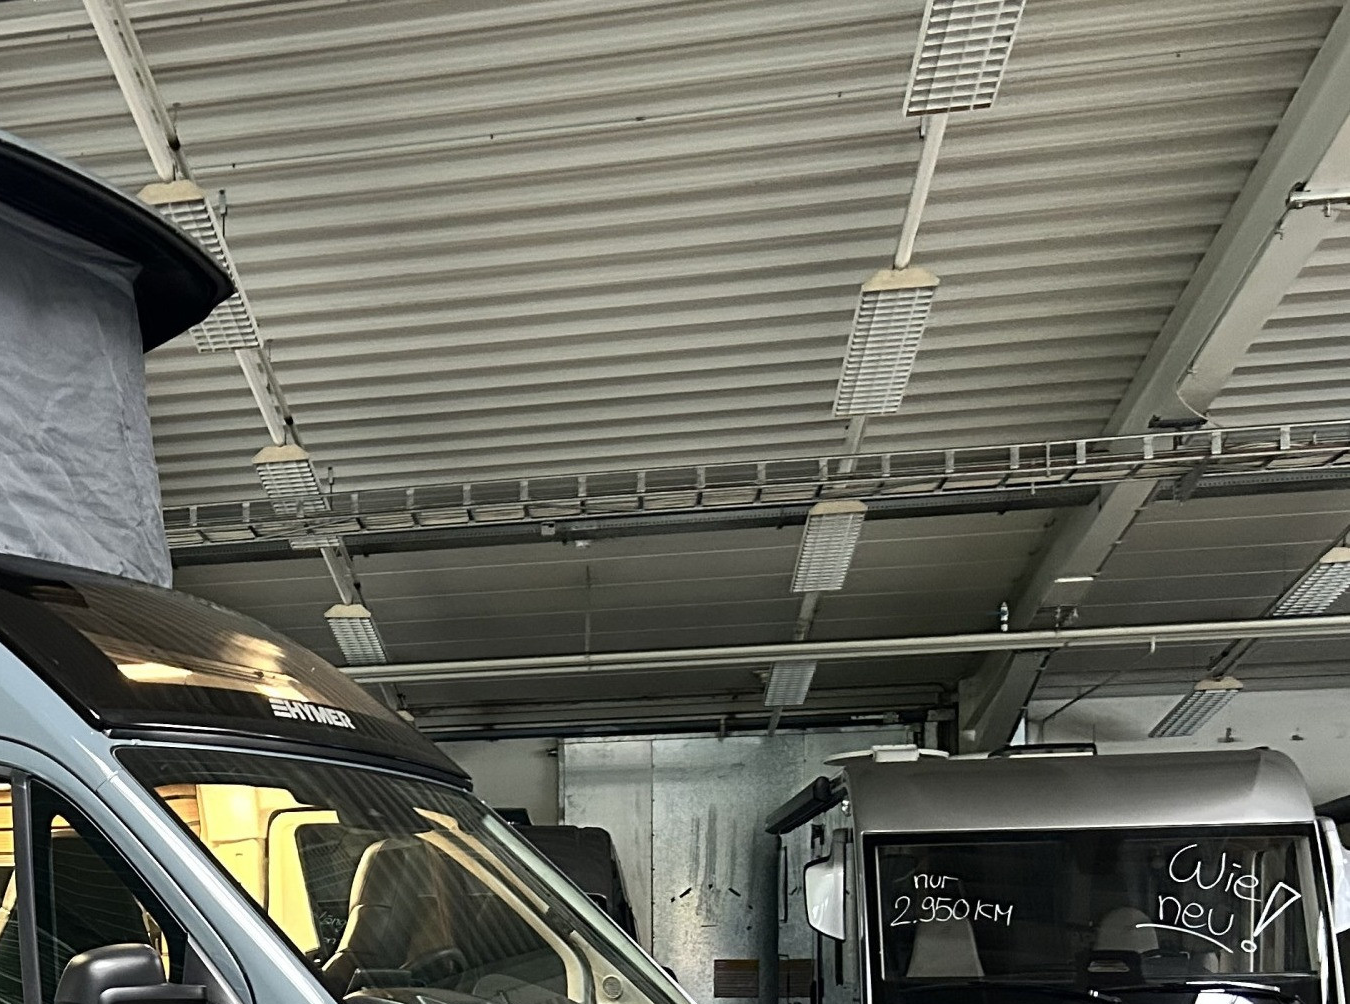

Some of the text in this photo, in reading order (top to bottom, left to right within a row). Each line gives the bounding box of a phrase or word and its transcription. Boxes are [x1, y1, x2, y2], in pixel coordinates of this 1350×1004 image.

[269, 698, 356, 729] HYMER
[913, 873, 959, 889] nur
[1169, 843, 1262, 902] Wie
[890, 896, 970, 927] 2.950
